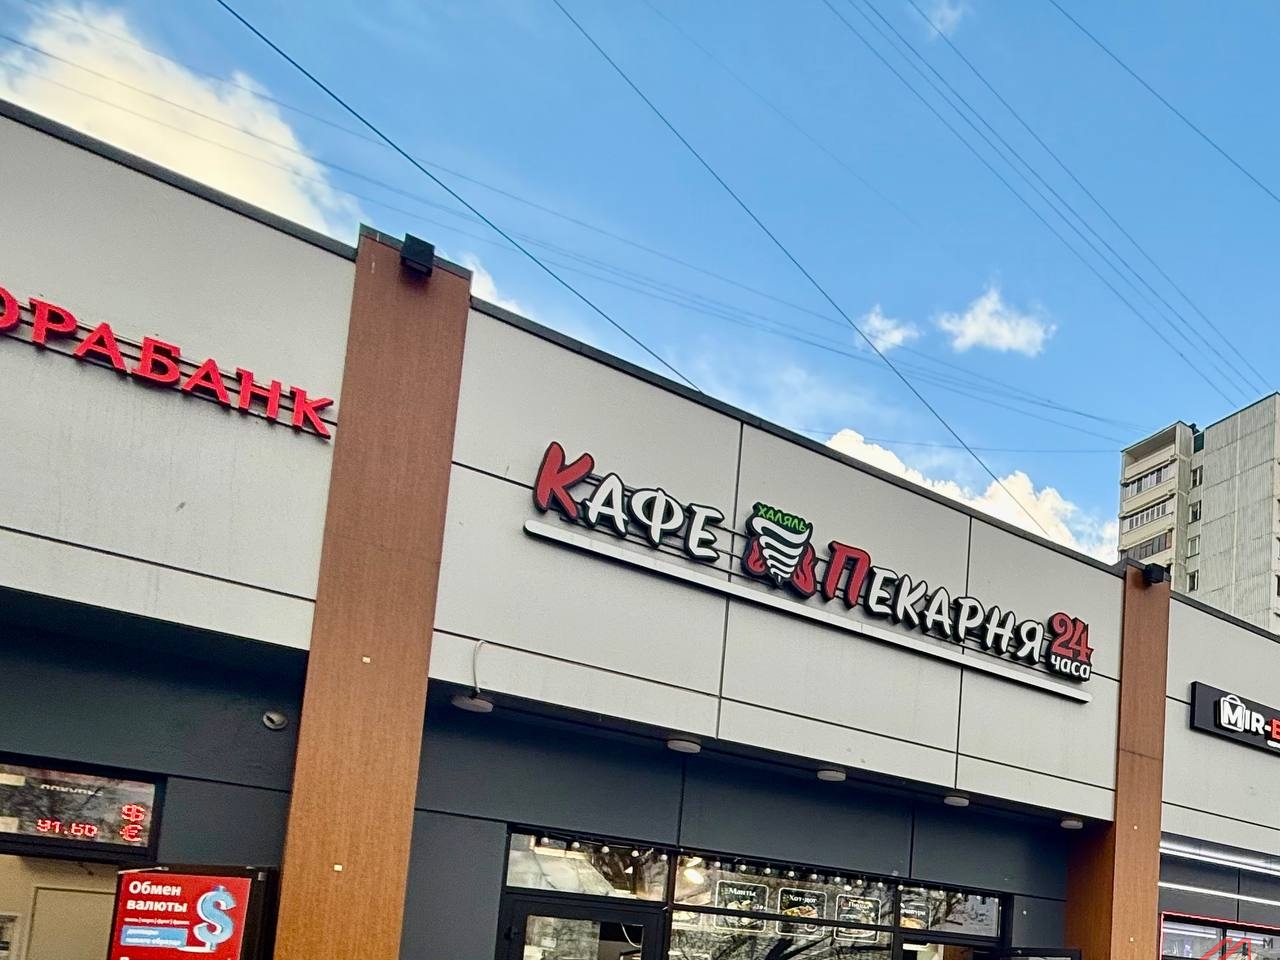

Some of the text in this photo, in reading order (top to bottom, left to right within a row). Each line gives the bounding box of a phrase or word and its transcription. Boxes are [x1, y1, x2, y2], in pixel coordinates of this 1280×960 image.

[758, 505, 807, 533] ХАЛЯЛЬ
[534, 441, 1044, 664] КАФЕ ПЕКАРНЯ
[1051, 613, 1093, 662] 24
[1050, 655, 1091, 679] часа
[129, 881, 182, 896] Обмен
[127, 900, 188, 913] валюты
